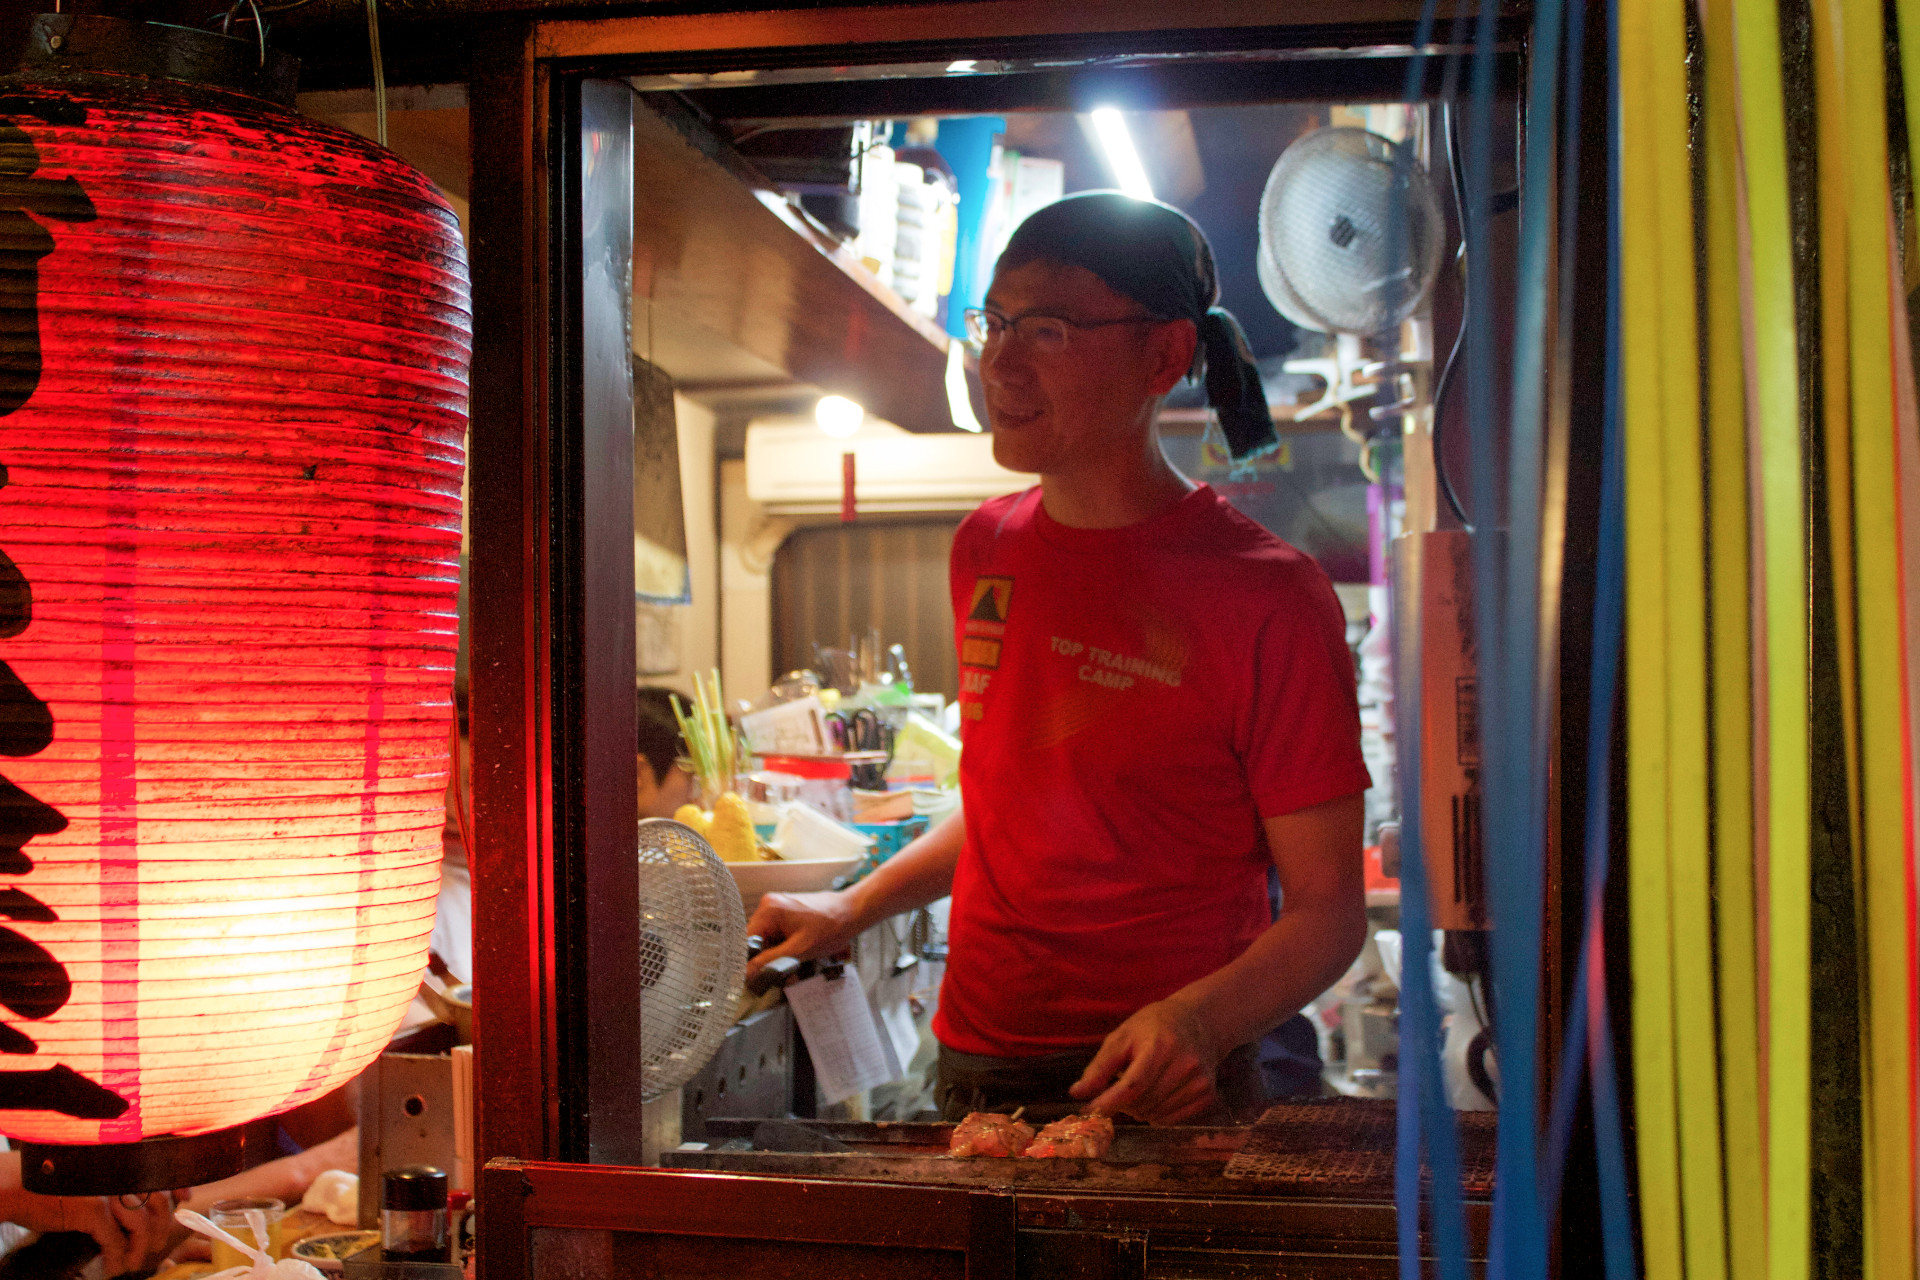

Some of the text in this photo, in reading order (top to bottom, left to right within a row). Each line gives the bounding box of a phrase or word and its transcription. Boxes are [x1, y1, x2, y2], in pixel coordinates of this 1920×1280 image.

[1051, 636, 1181, 687] TOP TRAINING
[1078, 664, 1135, 691] CAMP
